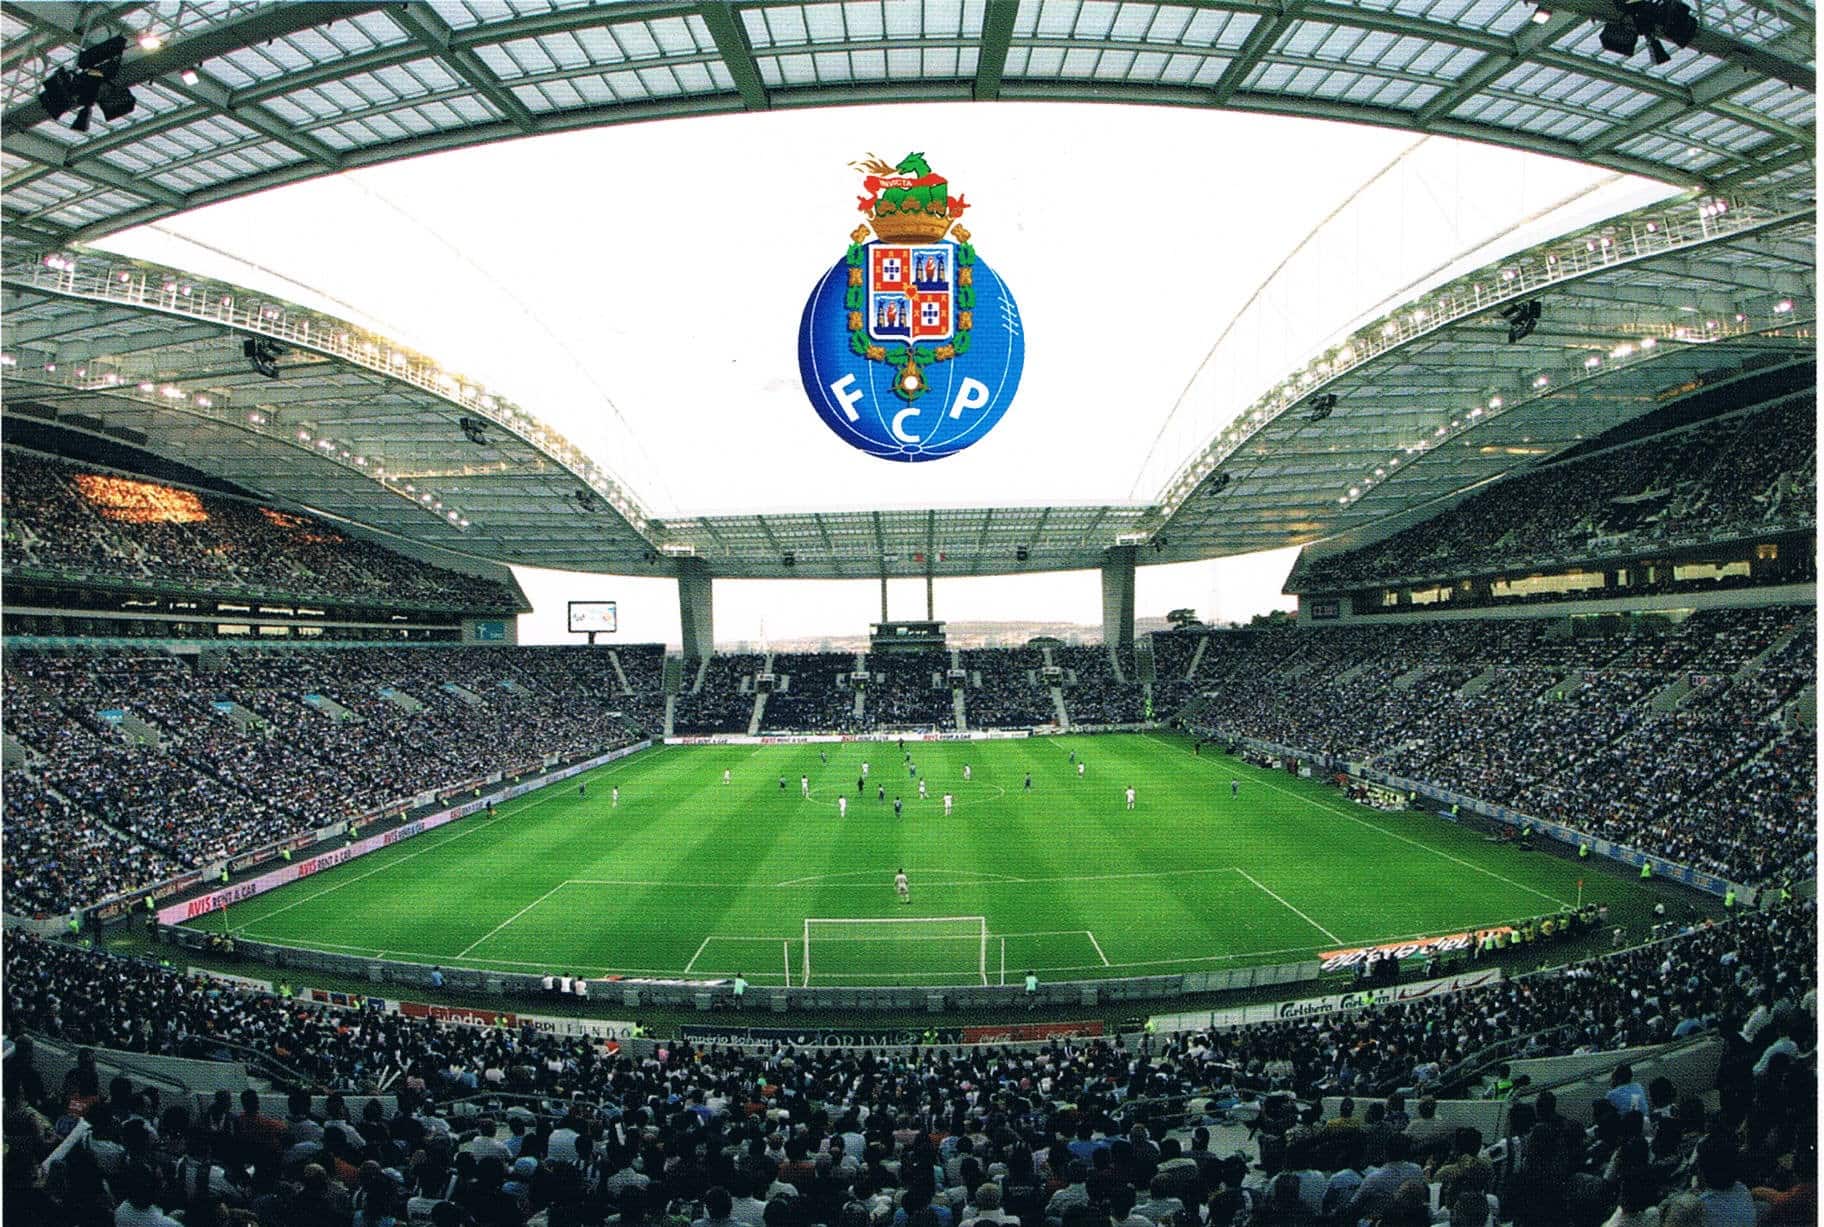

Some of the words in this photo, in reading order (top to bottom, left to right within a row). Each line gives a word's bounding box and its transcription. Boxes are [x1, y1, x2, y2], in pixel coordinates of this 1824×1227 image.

[299, 860, 318, 877] AVIS
[187, 895, 212, 918] AVIS
[212, 891, 233, 908] RENT
[234, 889, 241, 900] A
[242, 883, 257, 898] CAR
